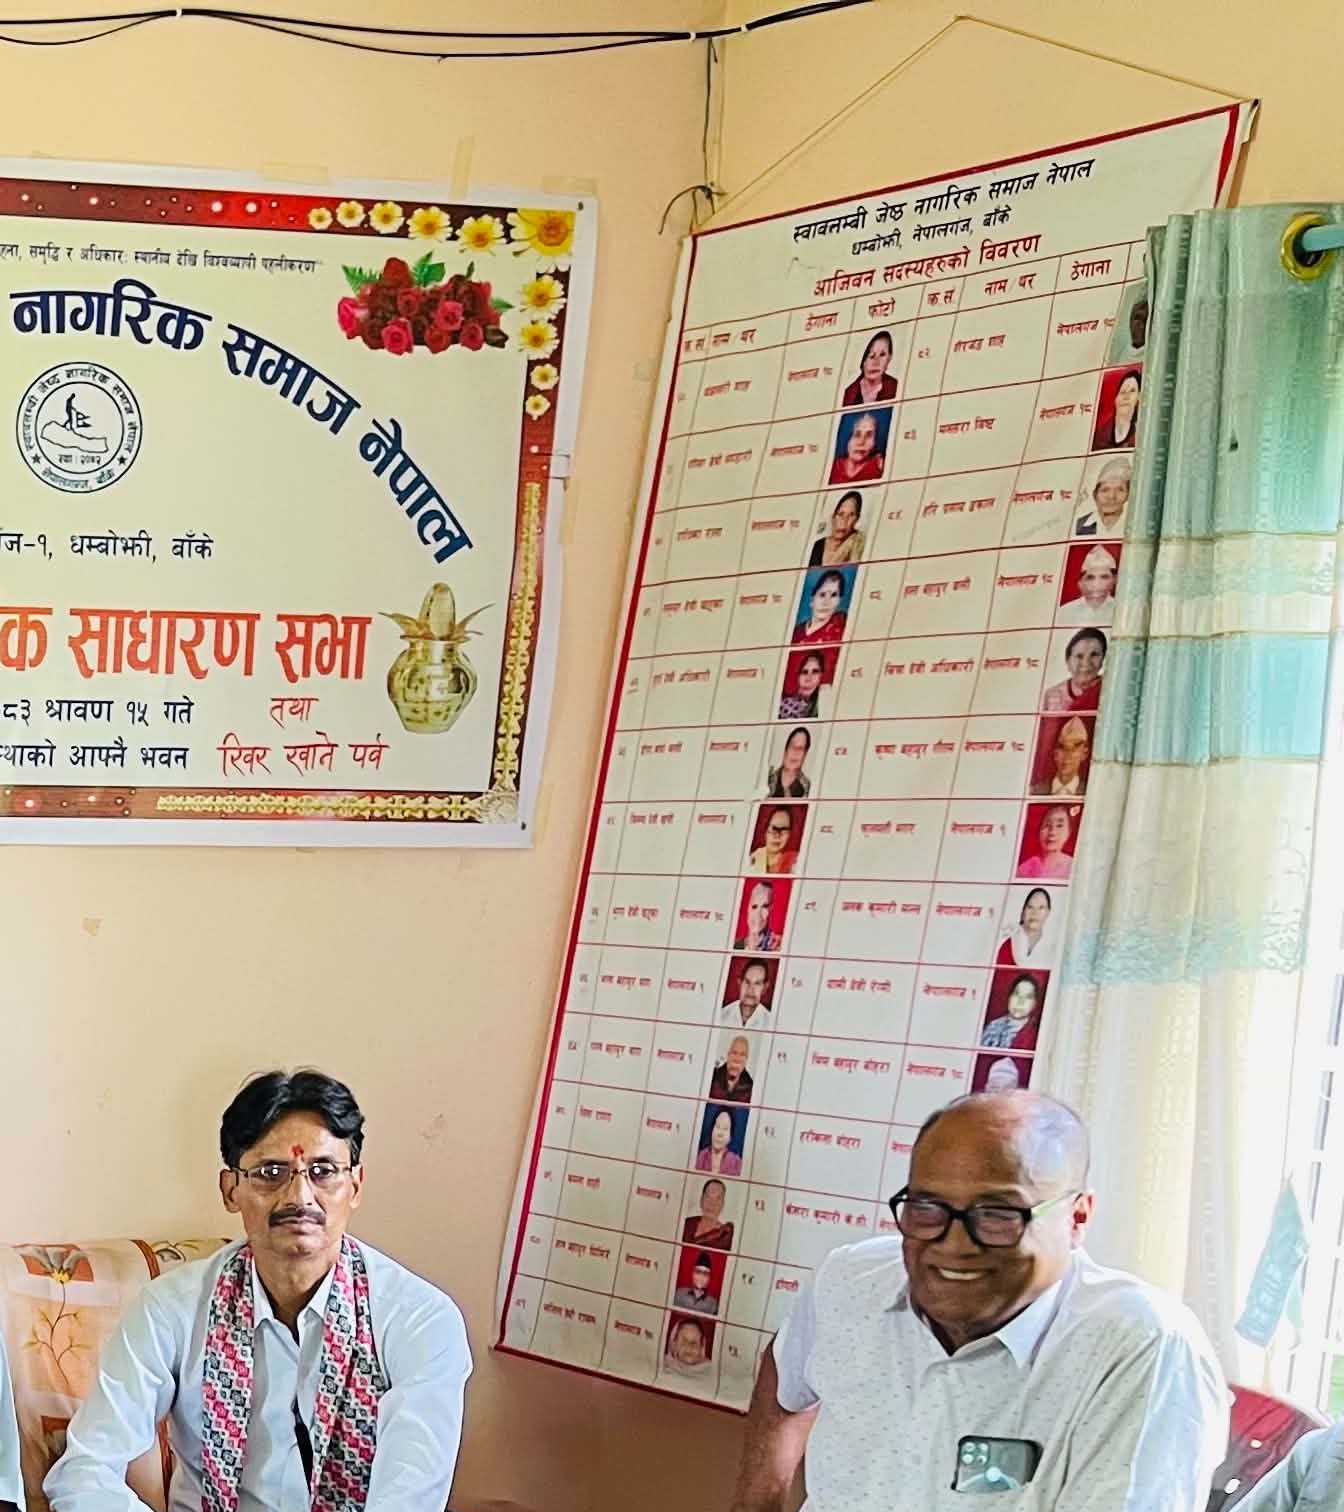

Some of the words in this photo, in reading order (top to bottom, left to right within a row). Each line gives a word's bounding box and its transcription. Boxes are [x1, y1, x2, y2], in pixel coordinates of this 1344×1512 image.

[875, 201, 907, 223] जेष्ठ
[913, 184, 980, 216] नागरिक
[988, 170, 1040, 201] समाज
[1045, 157, 1096, 188] नेपाल
[813, 269, 876, 297] आजिवन
[882, 245, 971, 284] सदस्यहरुको
[979, 233, 1042, 266] विवरण
[984, 278, 1008, 296] नाम
[1071, 259, 1112, 281] ठेगाना
[10, 278, 212, 352] नागरिक
[221, 322, 361, 436] समाज
[358, 417, 474, 565] नेपाल
[68, 607, 261, 680] साधारण
[274, 612, 372, 683] सभा
[45, 699, 114, 724] श्रावण
[127, 701, 149, 726] १५
[163, 695, 195, 725] गते
[270, 697, 320, 729] तथा
[140, 746, 190, 770] भवन
[347, 732, 391, 771] पर्व
